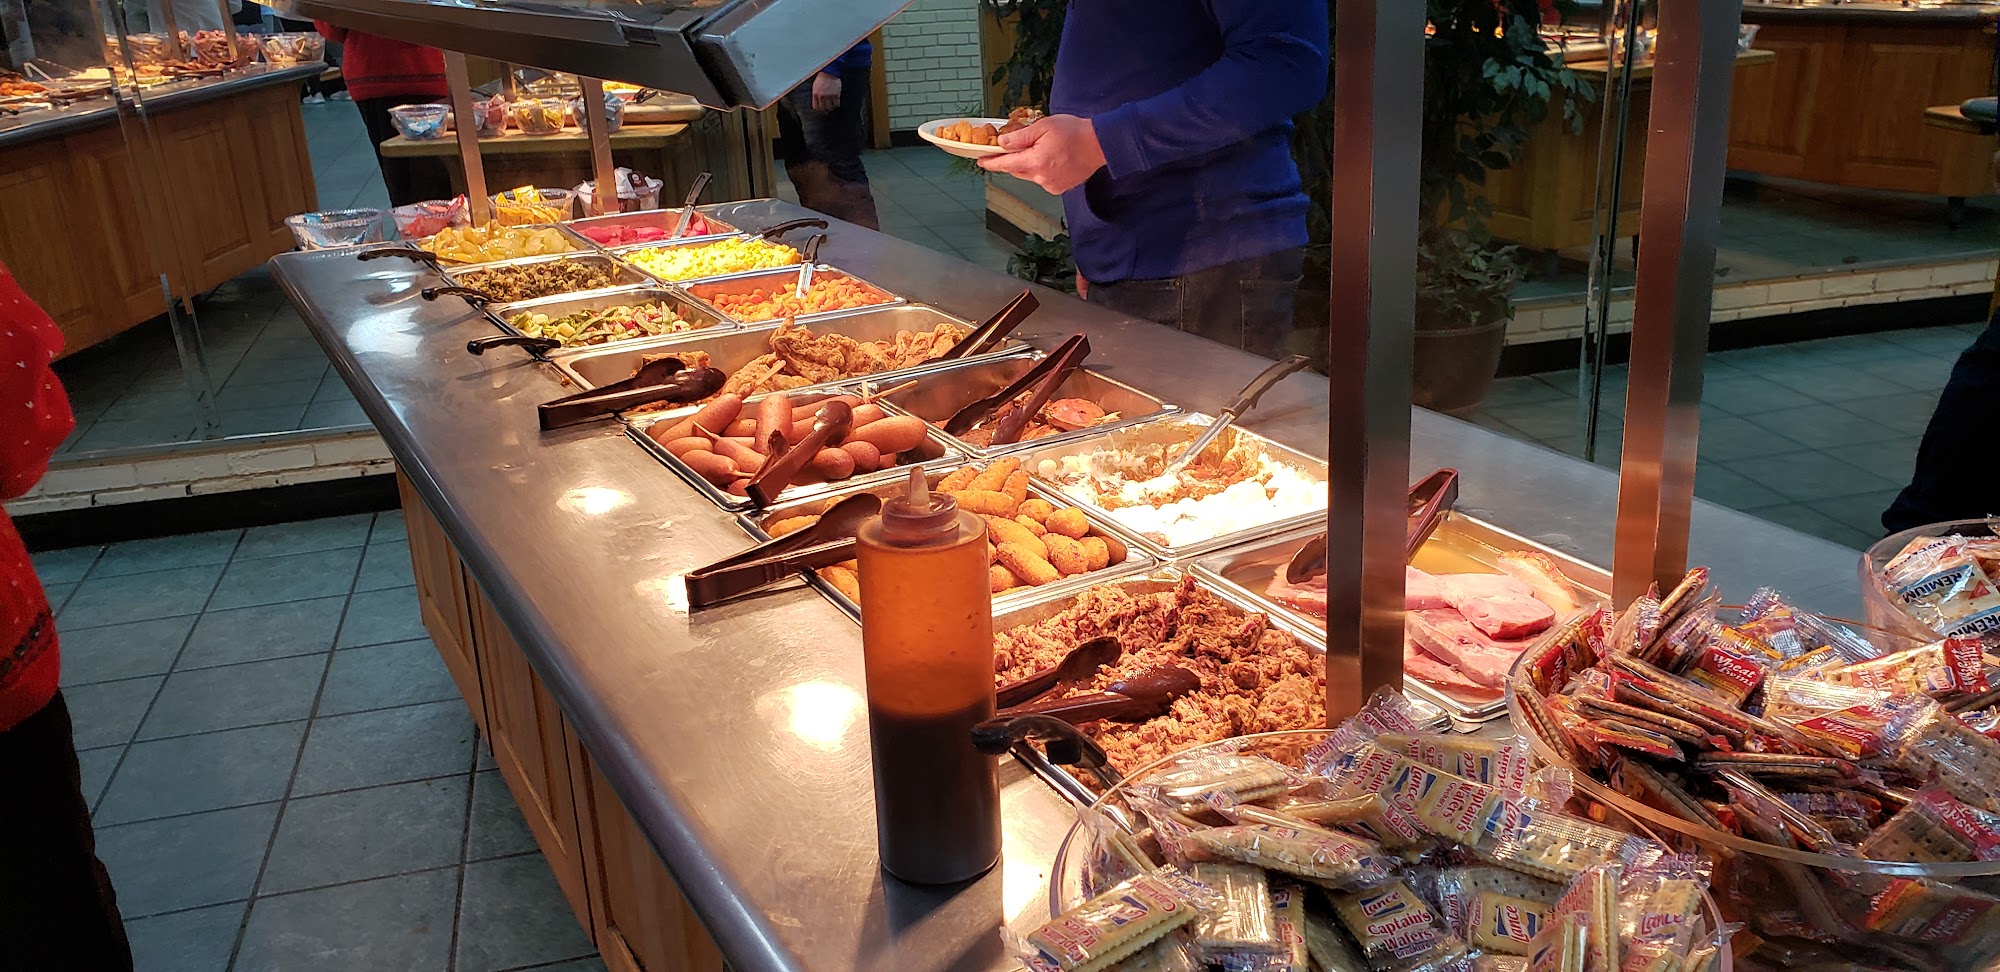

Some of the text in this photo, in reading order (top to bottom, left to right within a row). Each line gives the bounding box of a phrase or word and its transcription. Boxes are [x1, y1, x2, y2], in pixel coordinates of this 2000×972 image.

[1902, 571, 1975, 604] REMIUM
[1713, 653, 1757, 678] Wheat
[1719, 667, 1755, 687] Twins
[1354, 752, 1384, 785] Wafers
[1406, 765, 1427, 802] Lance
[1443, 783, 1473, 818] Wafers
[1457, 784, 1494, 832] Captain's
[1385, 805, 1416, 839] Wafers
[1501, 800, 1521, 842] Lance
[1362, 892, 1400, 916] Lance
[1367, 909, 1431, 936] Captain's
[1506, 906, 1530, 943] Lance
[1642, 914, 1682, 936] Lance
[1383, 929, 1433, 950] Wafers
